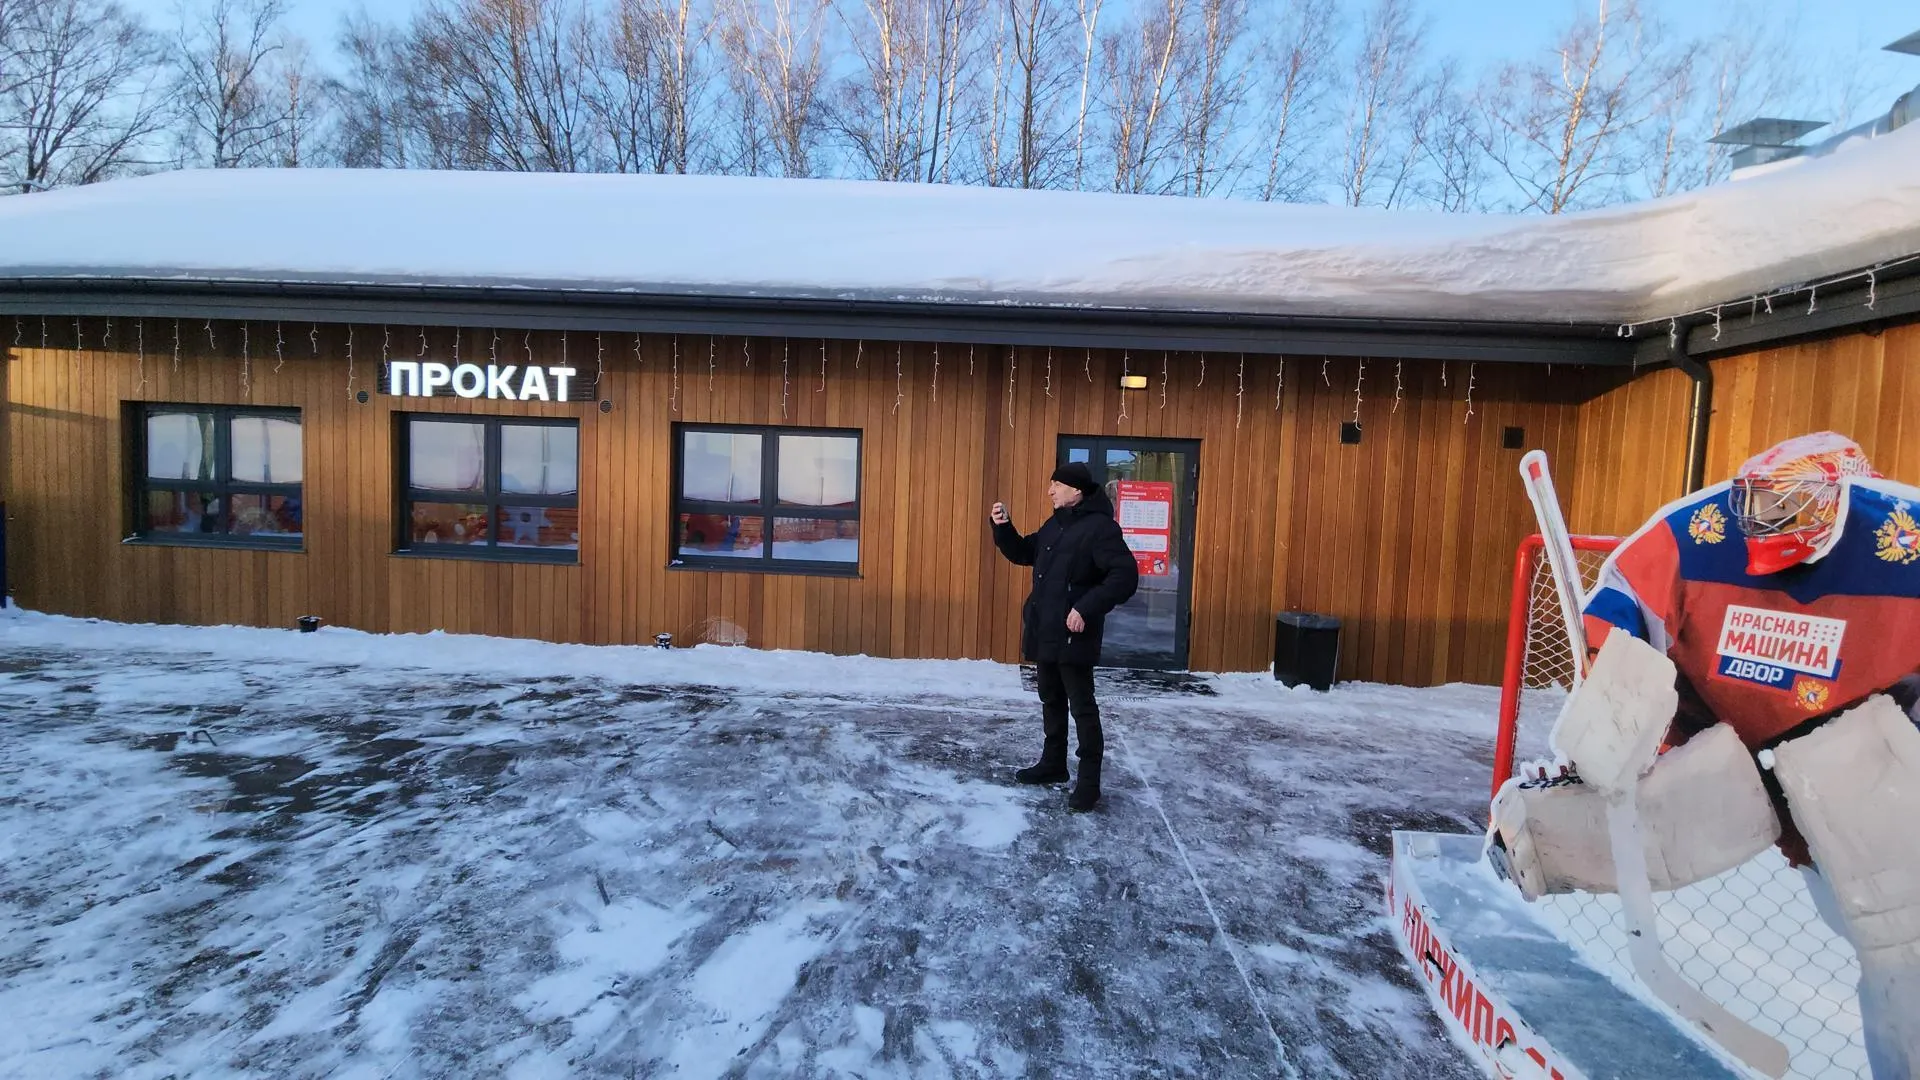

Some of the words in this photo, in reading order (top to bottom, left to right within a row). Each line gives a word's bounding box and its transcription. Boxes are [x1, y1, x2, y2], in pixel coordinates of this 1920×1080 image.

[389, 360, 577, 402] ПРОКАТ
[1730, 611, 1811, 638] КРАСНАЯ
[1723, 630, 1829, 670] МАШИНА
[1724, 659, 1784, 684] ДВОР
